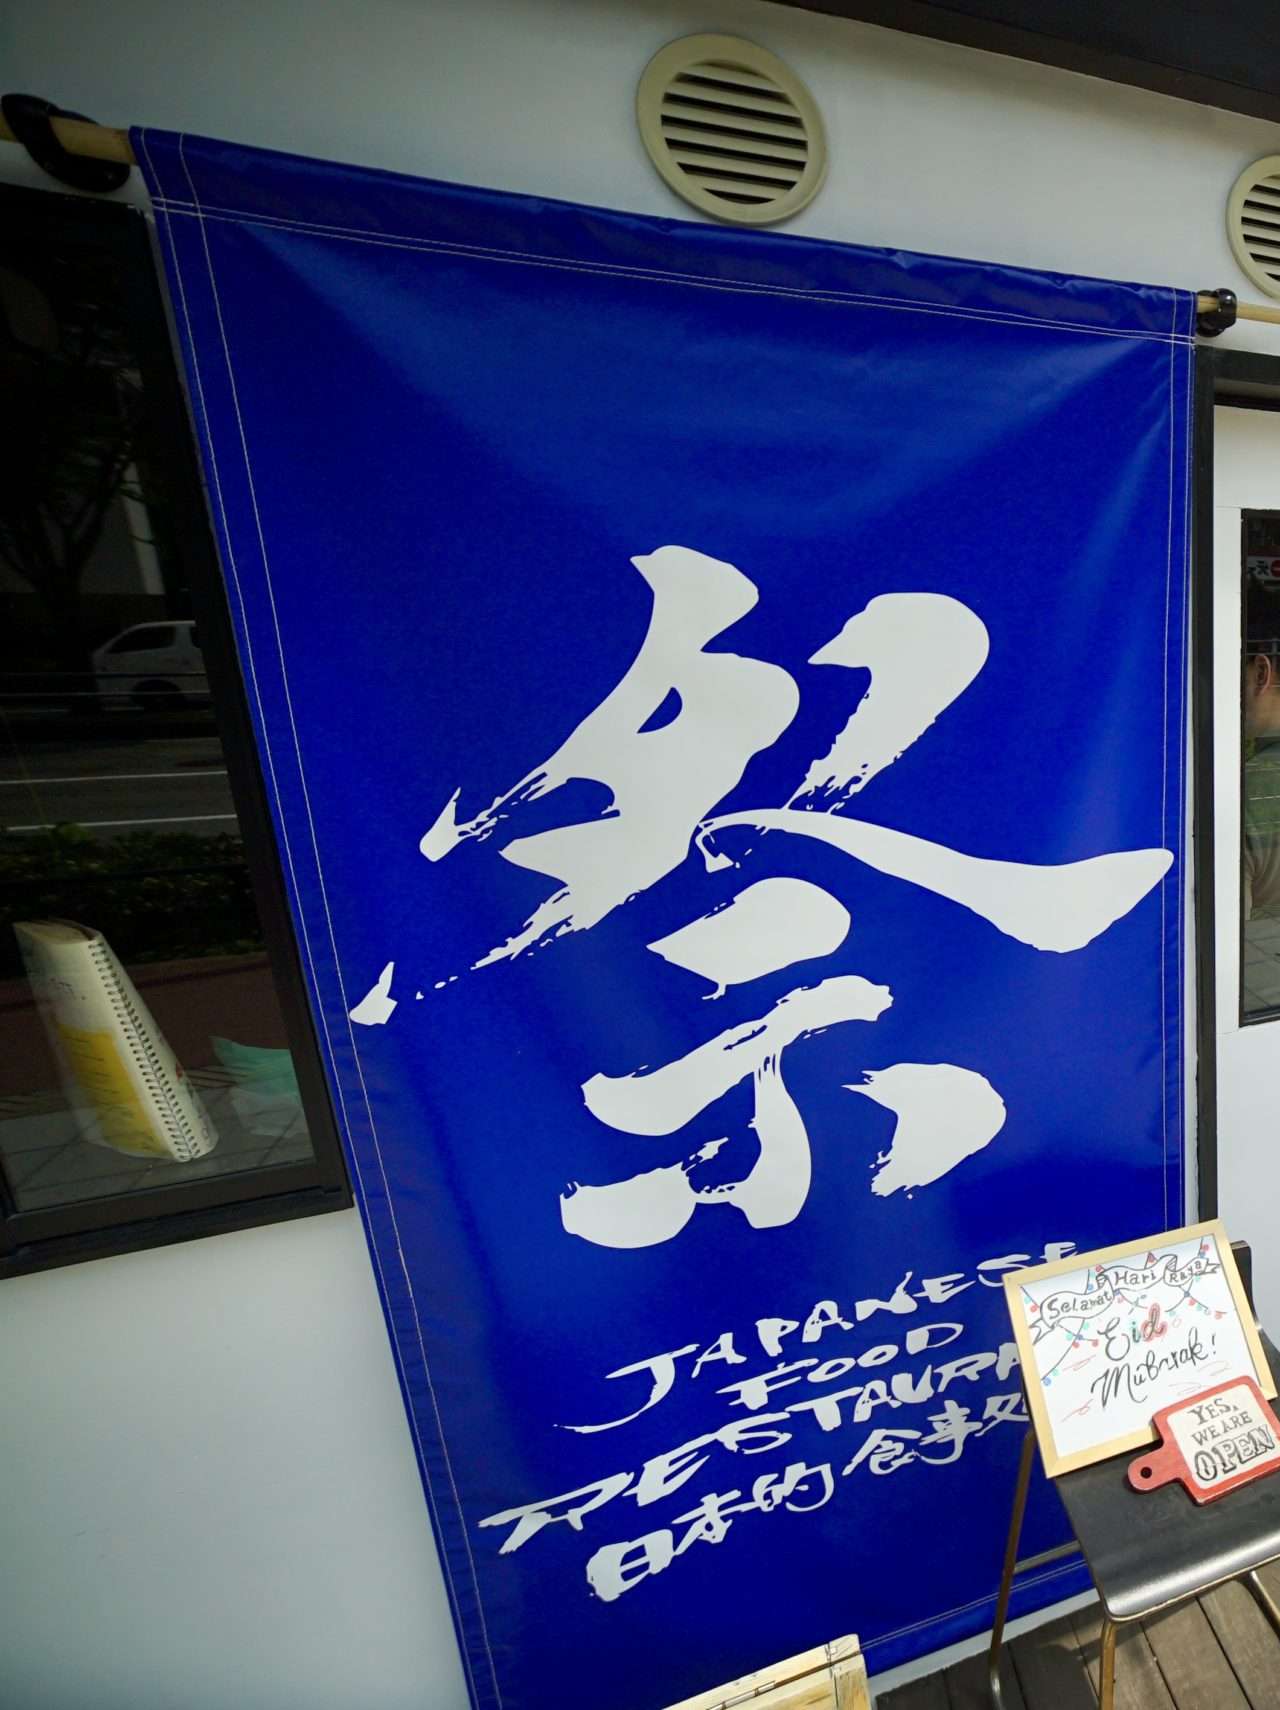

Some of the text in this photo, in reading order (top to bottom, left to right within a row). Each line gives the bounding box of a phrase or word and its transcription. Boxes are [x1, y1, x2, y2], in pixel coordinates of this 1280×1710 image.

[349, 545, 1174, 1248] 祭
[1048, 1259, 1203, 1320] Selamat Hari Raya
[554, 1242, 1078, 1434] JAPANESE
[1097, 1303, 1167, 1362] Eid
[717, 1322, 964, 1409] FOOD
[1187, 1397, 1239, 1426] YES,
[1192, 1410, 1253, 1446] WE ARE
[478, 1342, 1020, 1555] RESTAURA
[1194, 1423, 1276, 1482] OPEN
